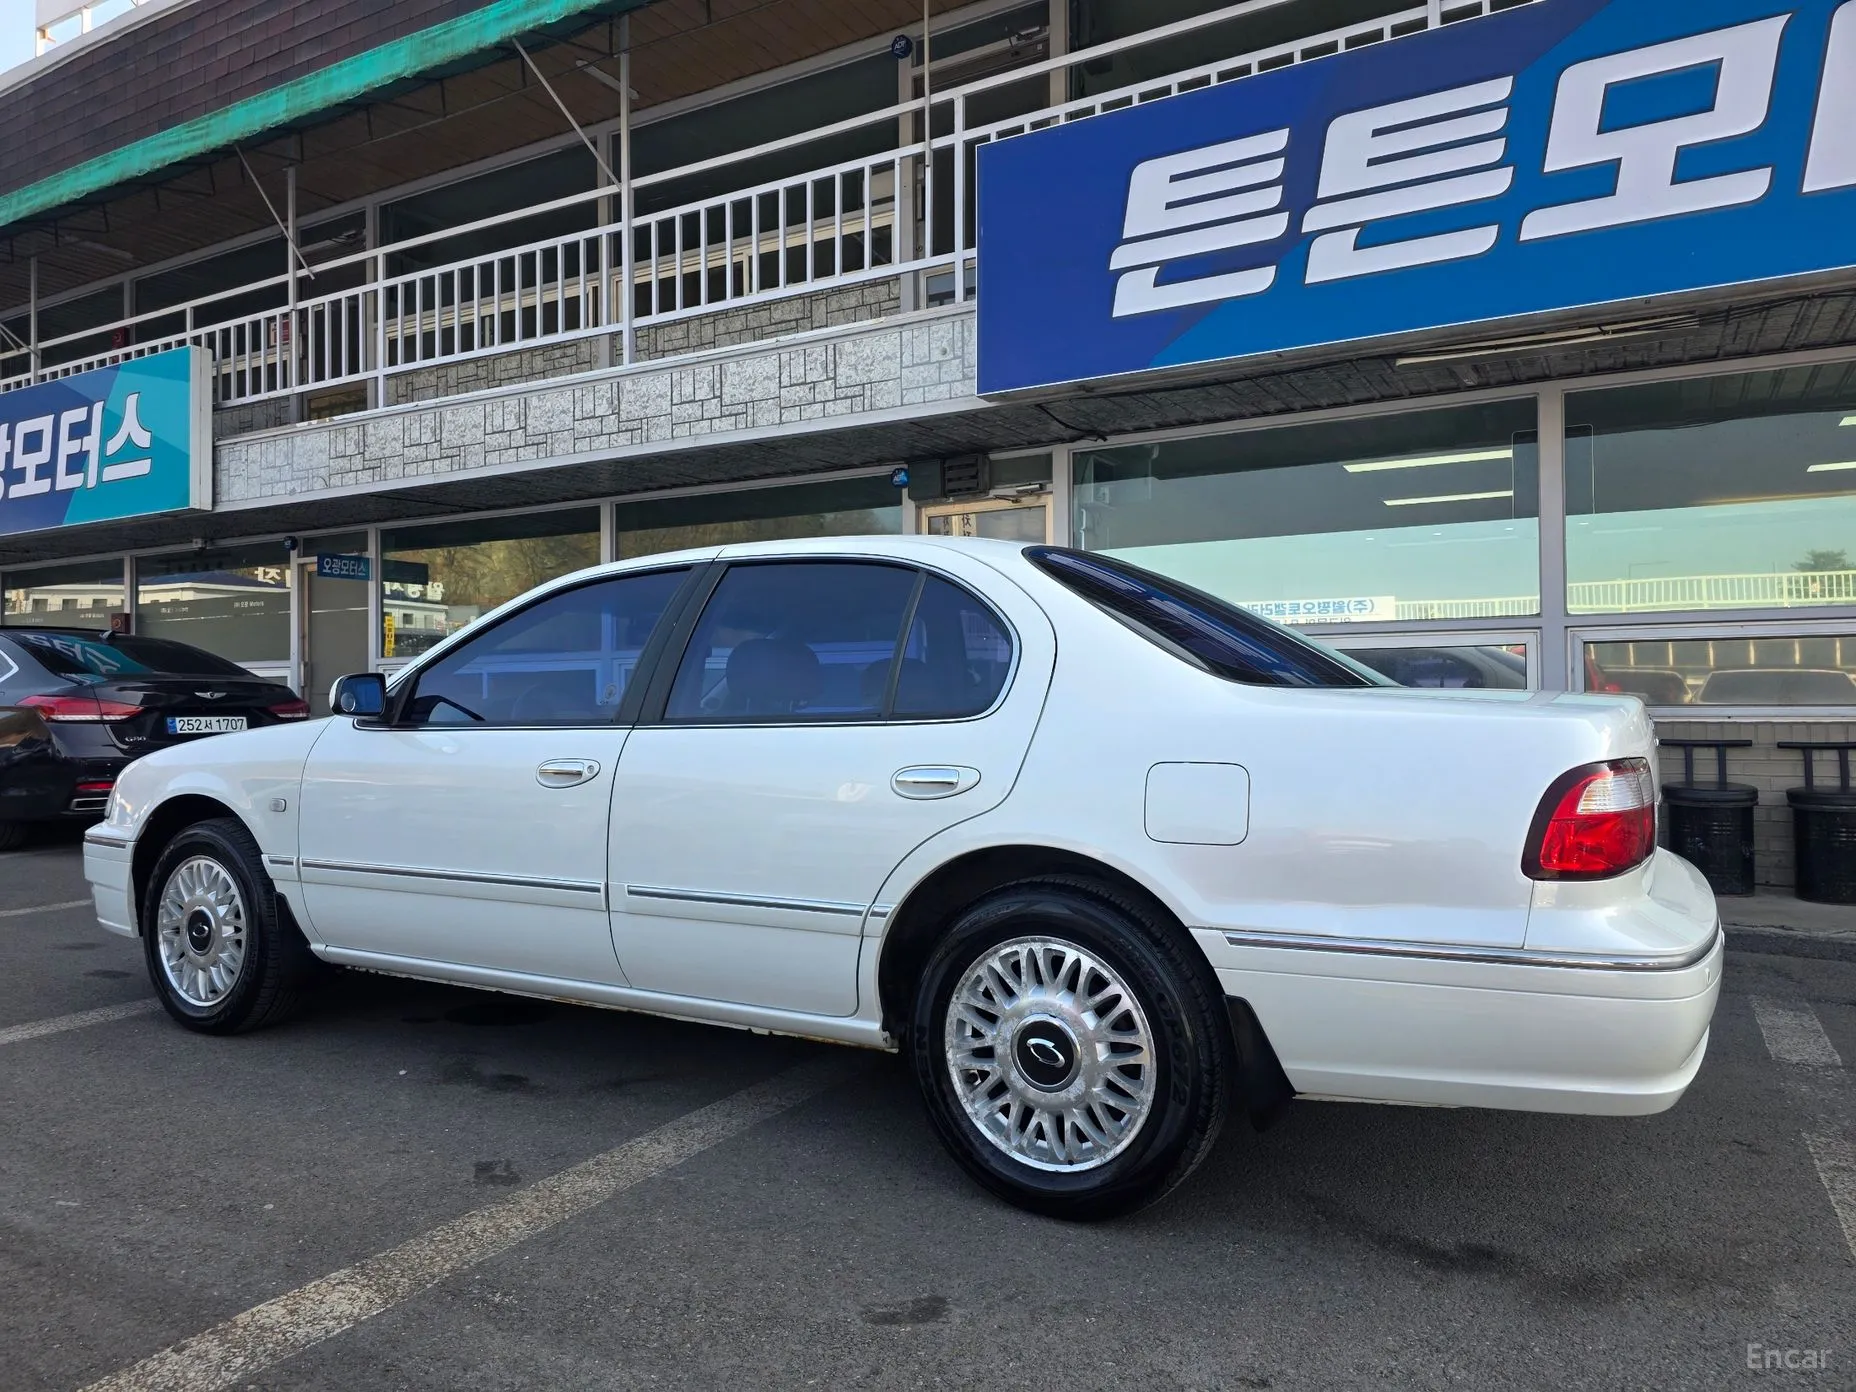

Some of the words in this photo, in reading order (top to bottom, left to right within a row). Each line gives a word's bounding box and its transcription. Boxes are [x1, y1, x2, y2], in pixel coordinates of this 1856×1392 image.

[323, 557, 366, 577] 오광모터스
[178, 718, 213, 732] 252서
[216, 718, 245, 731] 1707
